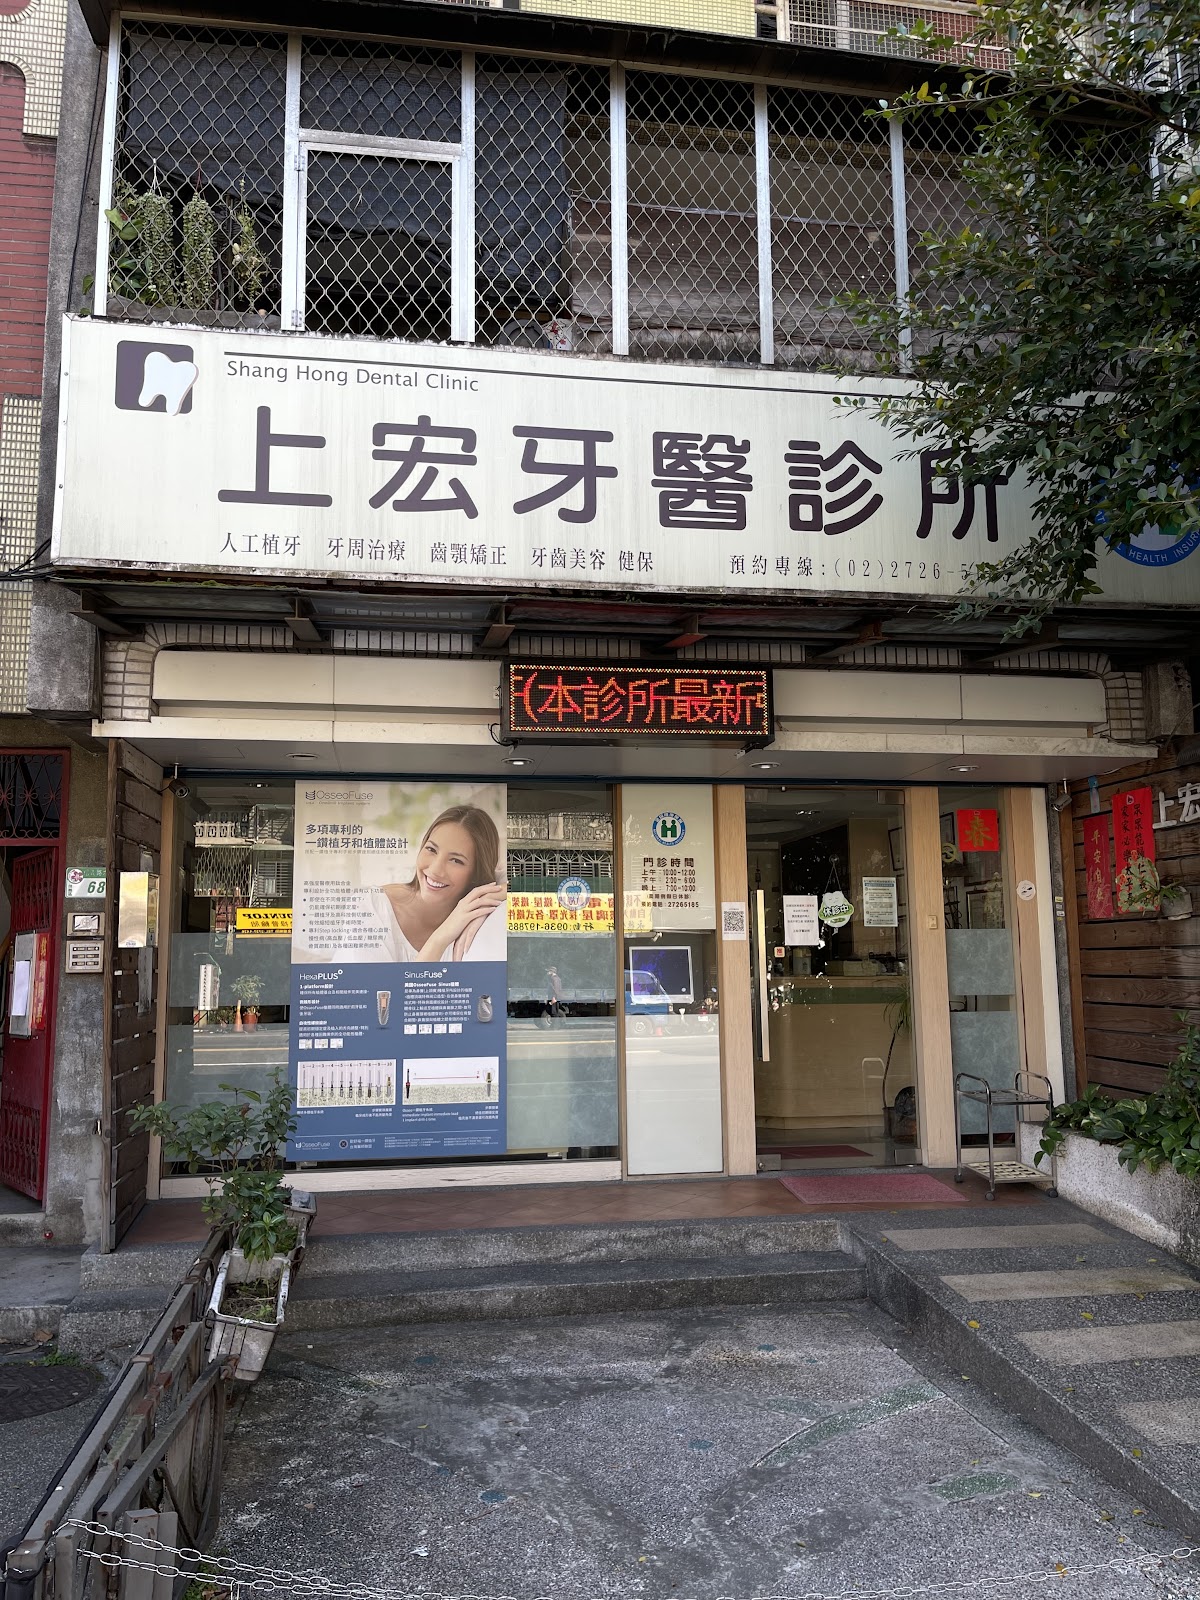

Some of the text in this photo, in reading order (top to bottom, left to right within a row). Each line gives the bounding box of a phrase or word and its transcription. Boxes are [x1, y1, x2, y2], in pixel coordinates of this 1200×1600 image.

[227, 361, 479, 391] Shang Hong Dental Clinic
[217, 405, 1012, 542] 上宏牙醫診所
[220, 532, 654, 573] 人工植牙 牙周治療 齒顎矯正 牙齒美容 健保
[1128, 549, 1168, 563] HEALTH
[513, 671, 765, 725] (本診所最新
[316, 789, 374, 800] OsseoFuse
[305, 824, 363, 836] 多項專利的
[964, 815, 993, 848] 春
[305, 837, 409, 849] 一鑽植牙和植體設計
[643, 857, 695, 868] 門診時間
[88, 881, 106, 894] 68
[822, 903, 850, 917] 休診中
[299, 971, 340, 981] HexaPLUS
[404, 970, 443, 979] SinusFuse
